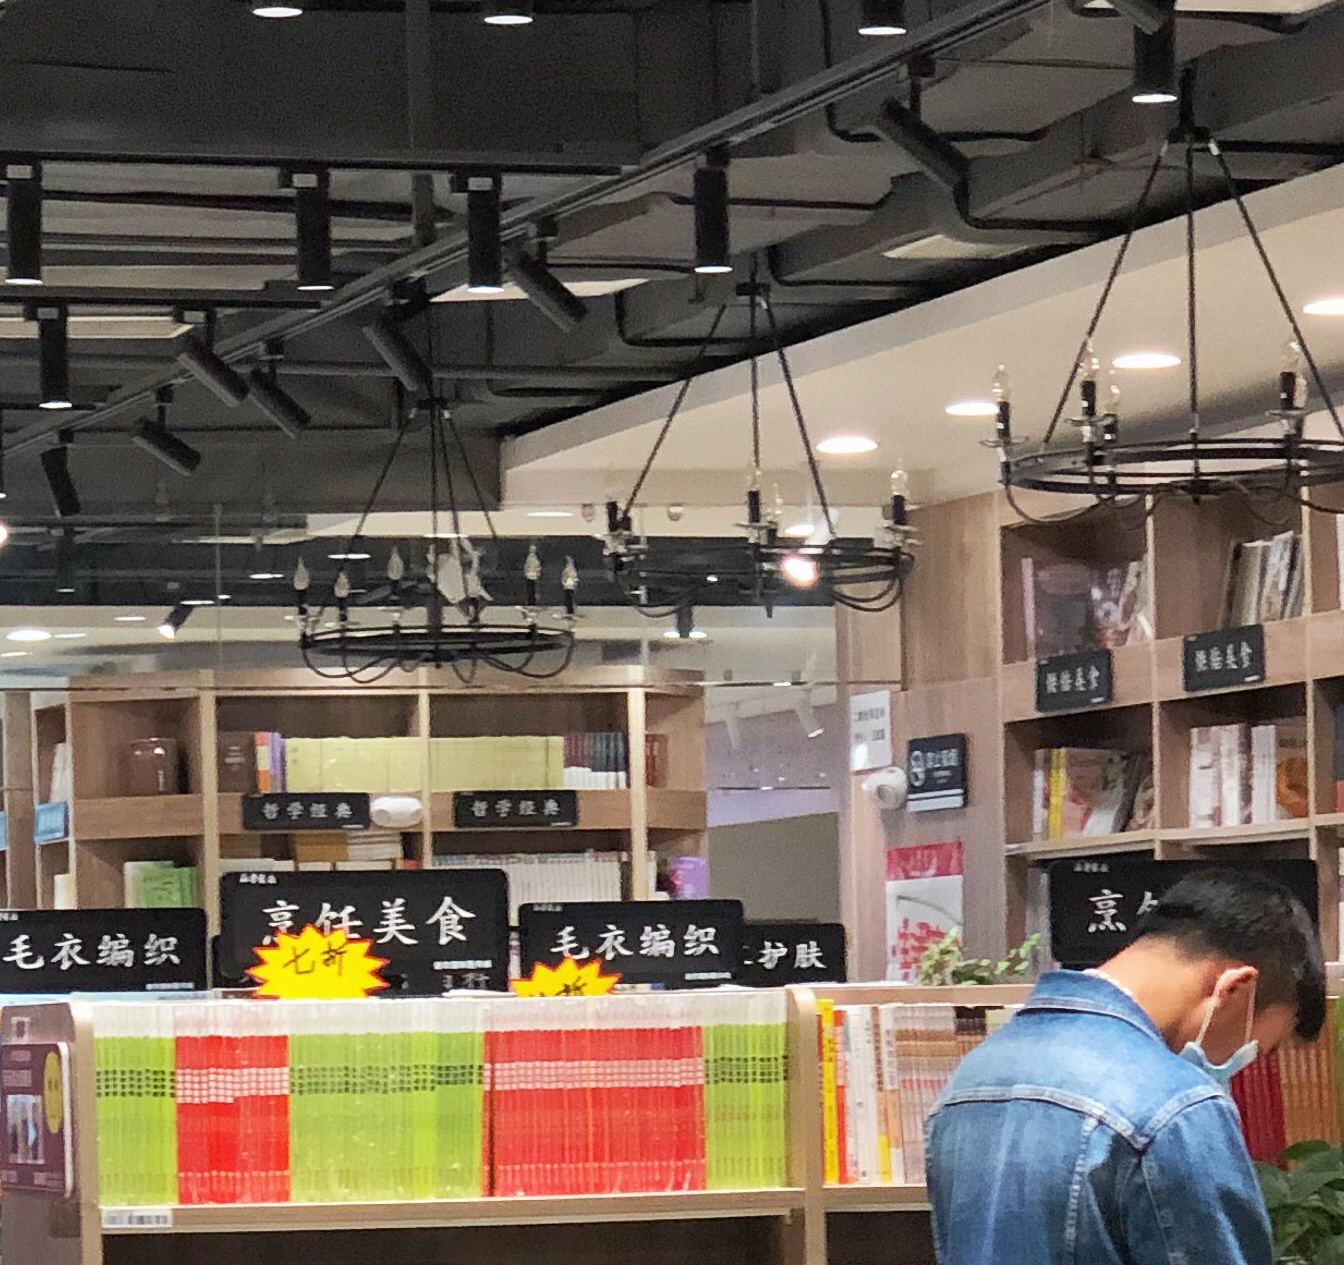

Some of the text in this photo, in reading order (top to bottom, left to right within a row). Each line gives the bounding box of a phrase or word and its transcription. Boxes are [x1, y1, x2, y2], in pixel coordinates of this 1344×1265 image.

[262, 896, 477, 945] 烹饪美食
[1, 932, 183, 971] 毛衣编织
[282, 940, 348, 977] 七折
[549, 923, 720, 960] 毛衣编织
[742, 940, 827, 970] 护肤
